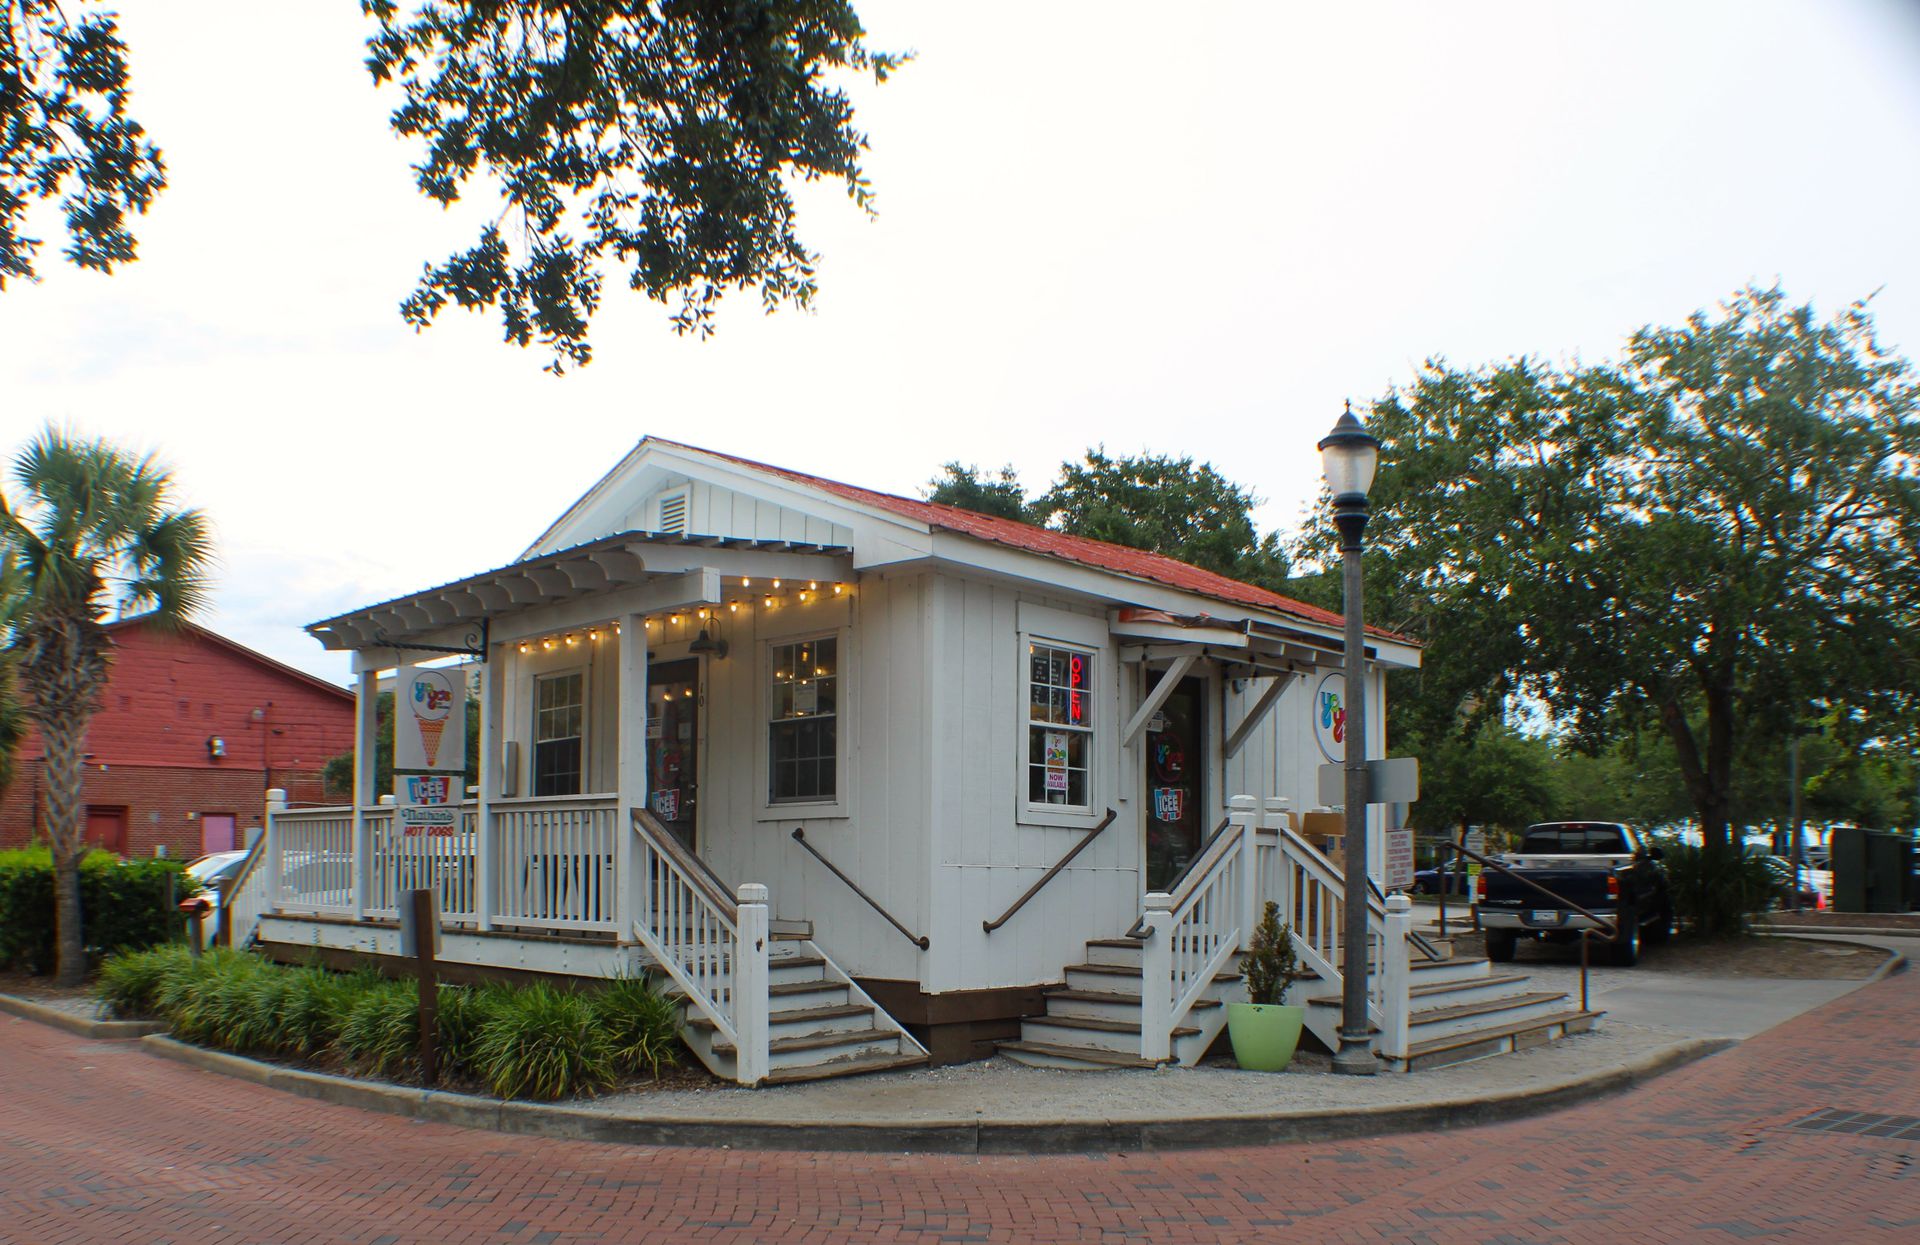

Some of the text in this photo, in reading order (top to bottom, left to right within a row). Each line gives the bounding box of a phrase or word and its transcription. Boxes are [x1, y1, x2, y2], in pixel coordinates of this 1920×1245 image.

[1072, 657, 1082, 720] OPEN
[1049, 773, 1064, 781] NOW
[413, 782, 443, 798] ICEE
[1159, 795, 1178, 812] ICEE
[404, 826, 454, 836] HOT DOGS
